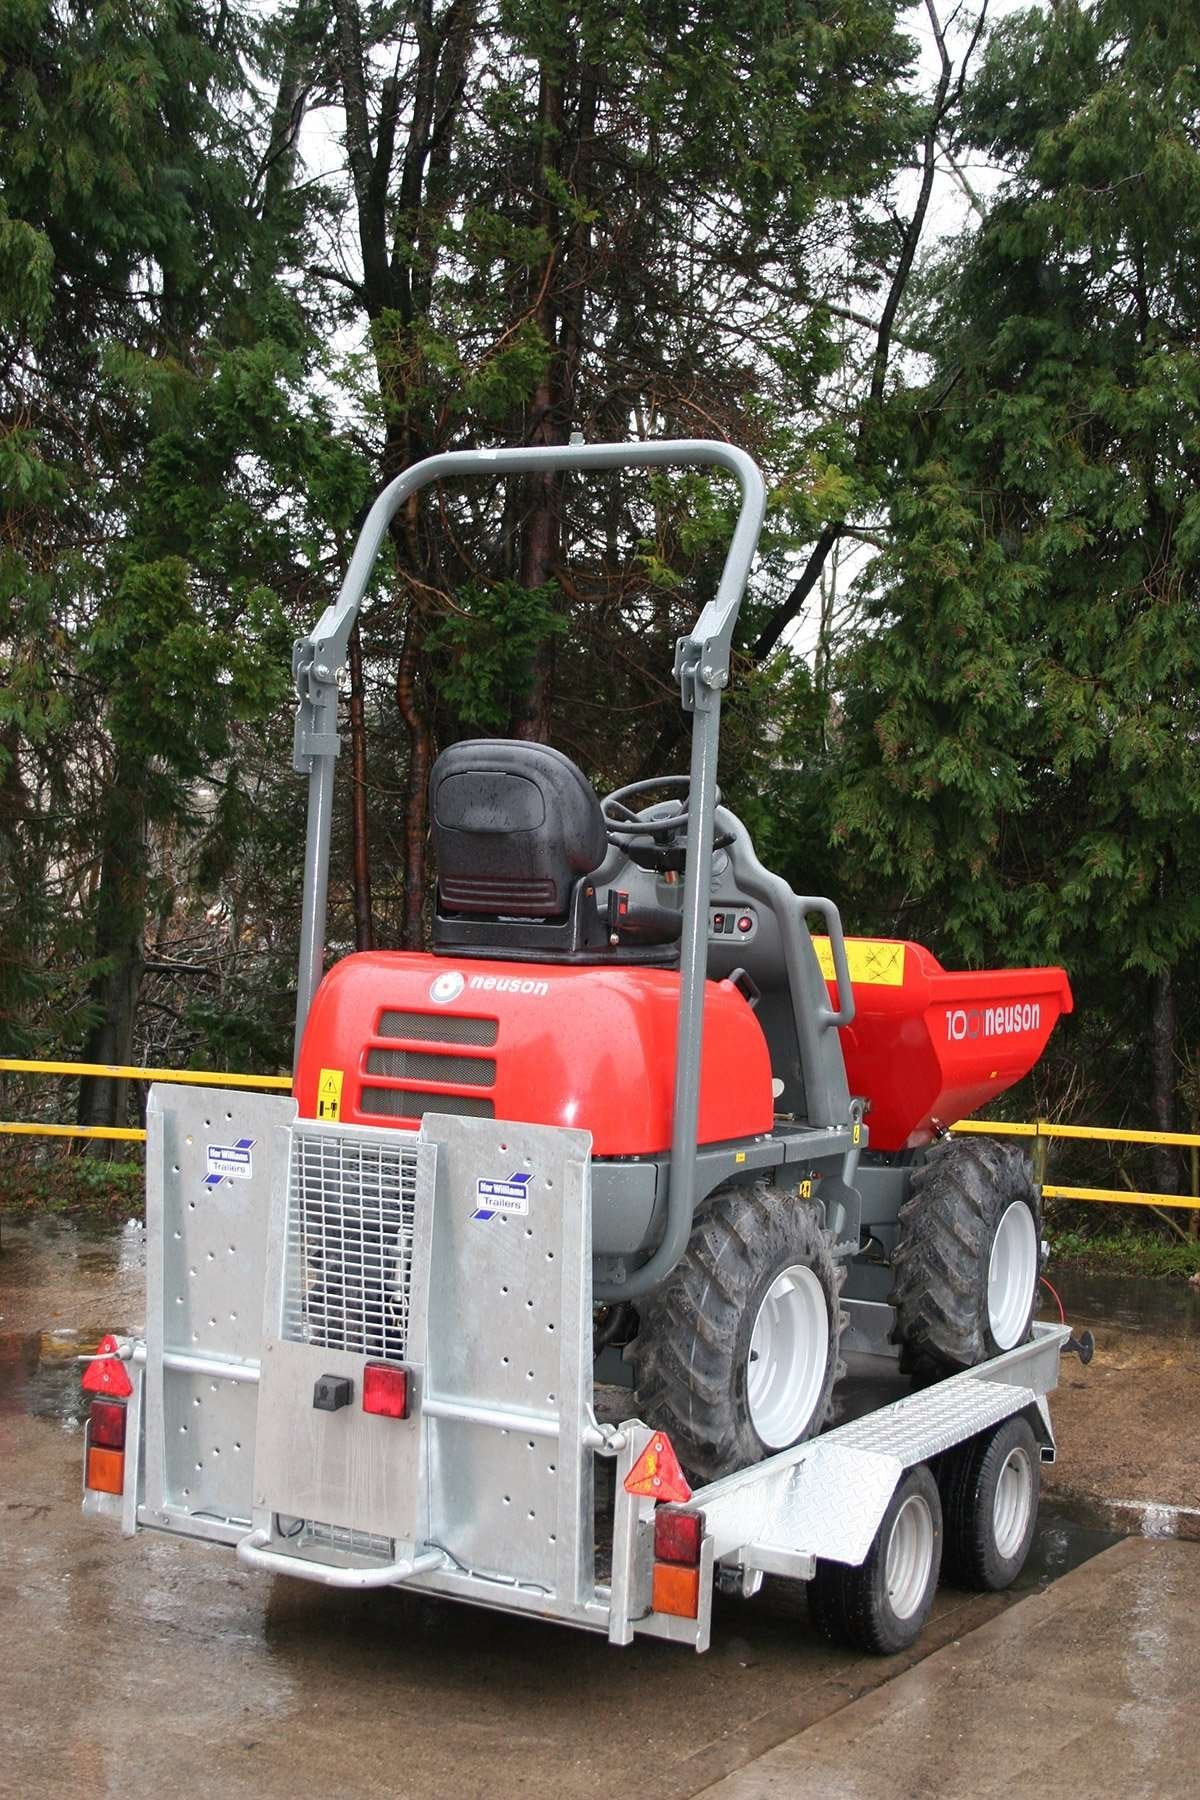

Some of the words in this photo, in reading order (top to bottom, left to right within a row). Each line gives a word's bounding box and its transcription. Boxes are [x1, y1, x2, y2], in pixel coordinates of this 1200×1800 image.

[469, 975, 549, 996] neuson
[985, 1003, 1040, 1036] neuson
[213, 1161, 246, 1174] Trailers
[493, 1183, 525, 1198] Williams
[485, 1196, 521, 1210] Trailers
